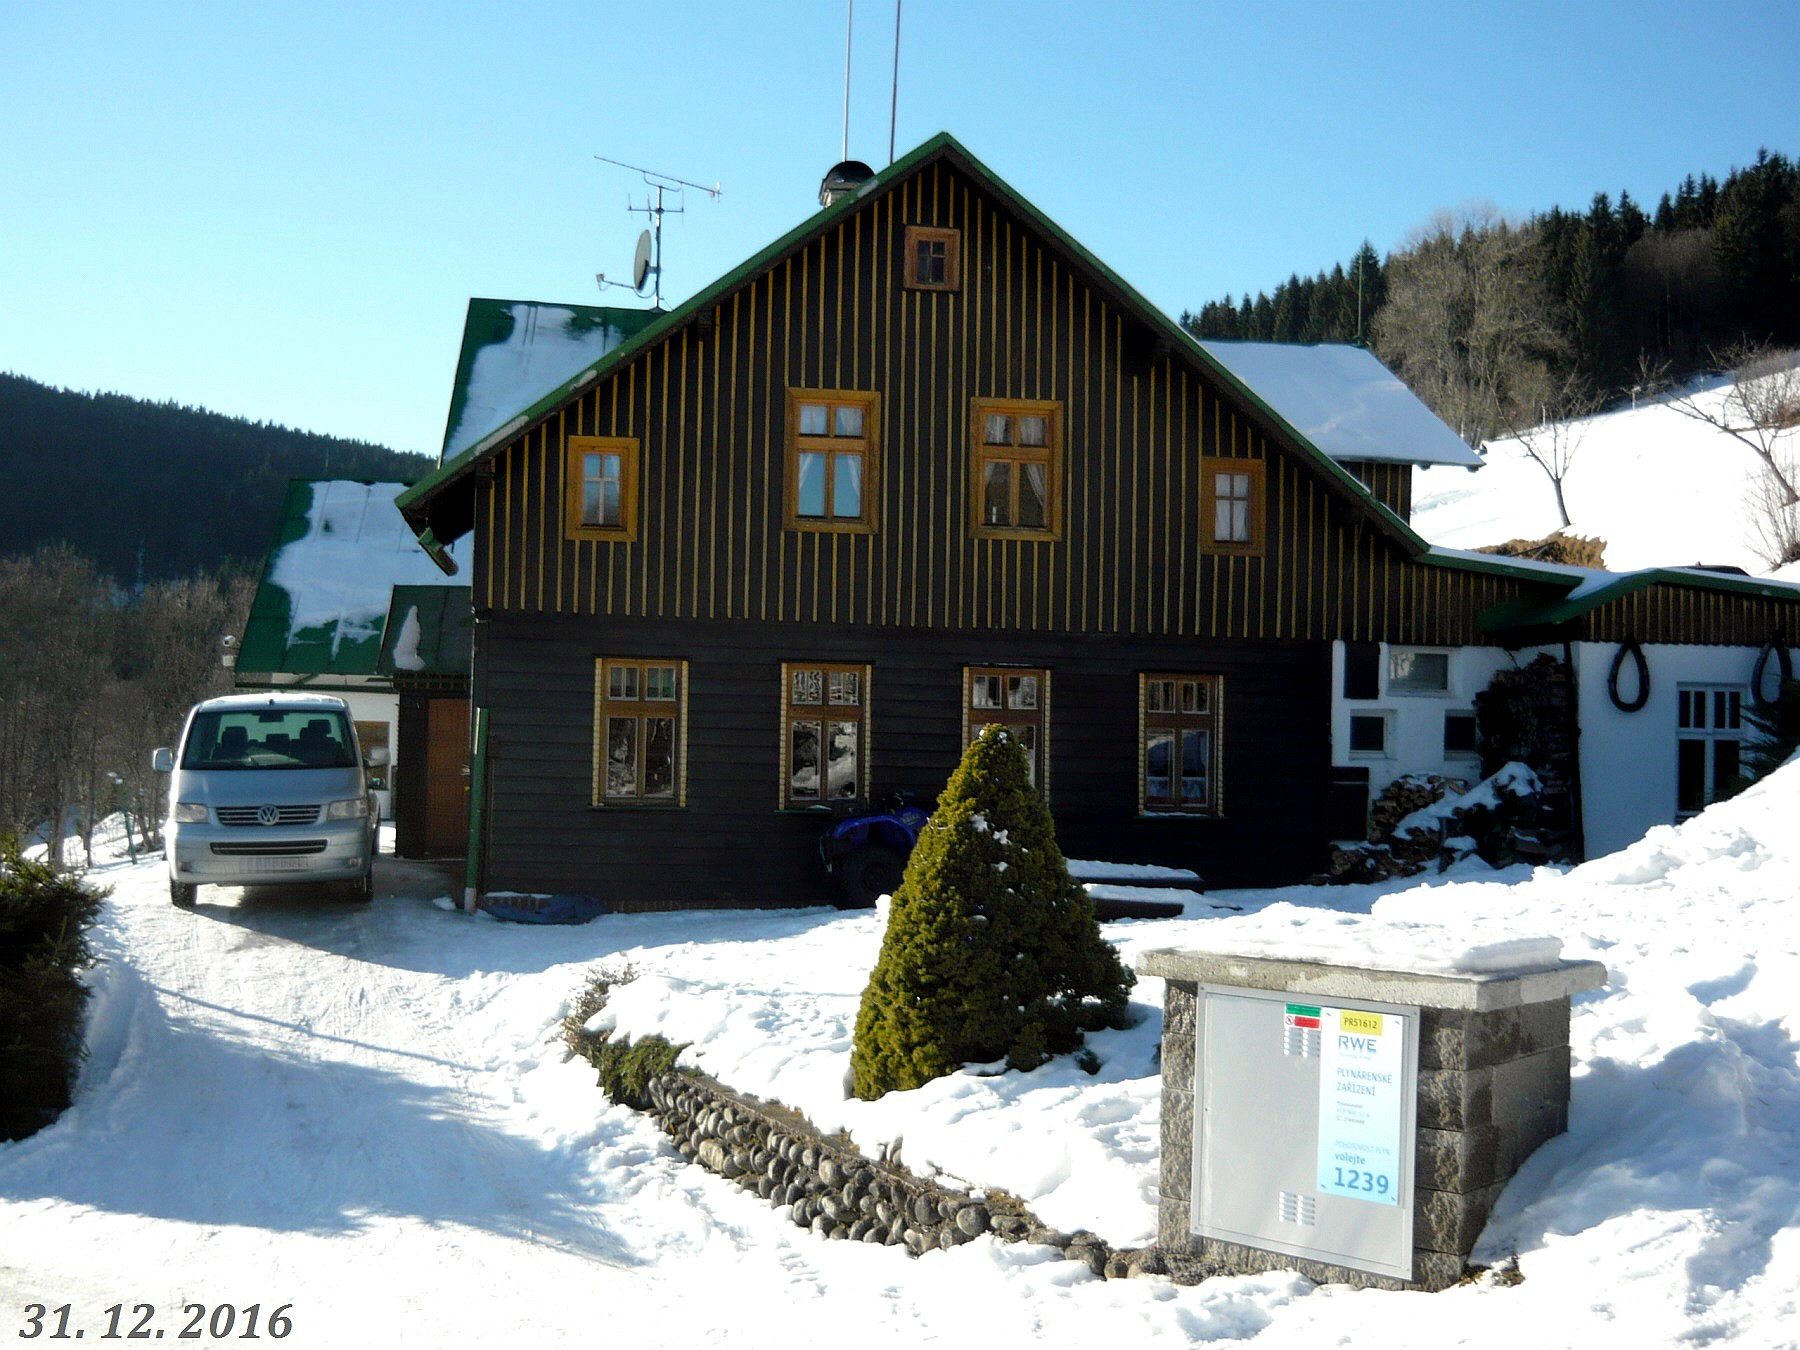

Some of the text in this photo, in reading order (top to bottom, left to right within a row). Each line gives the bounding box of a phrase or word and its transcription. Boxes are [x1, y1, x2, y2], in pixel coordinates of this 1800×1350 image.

[1343, 1017, 1378, 1029] PR51612
[1338, 1035, 1377, 1053] RWE
[1337, 1067, 1392, 1084] PLYNÁRENSKÉ
[1334, 1152, 1366, 1165] volejte
[1334, 1167, 1389, 1194] 1239
